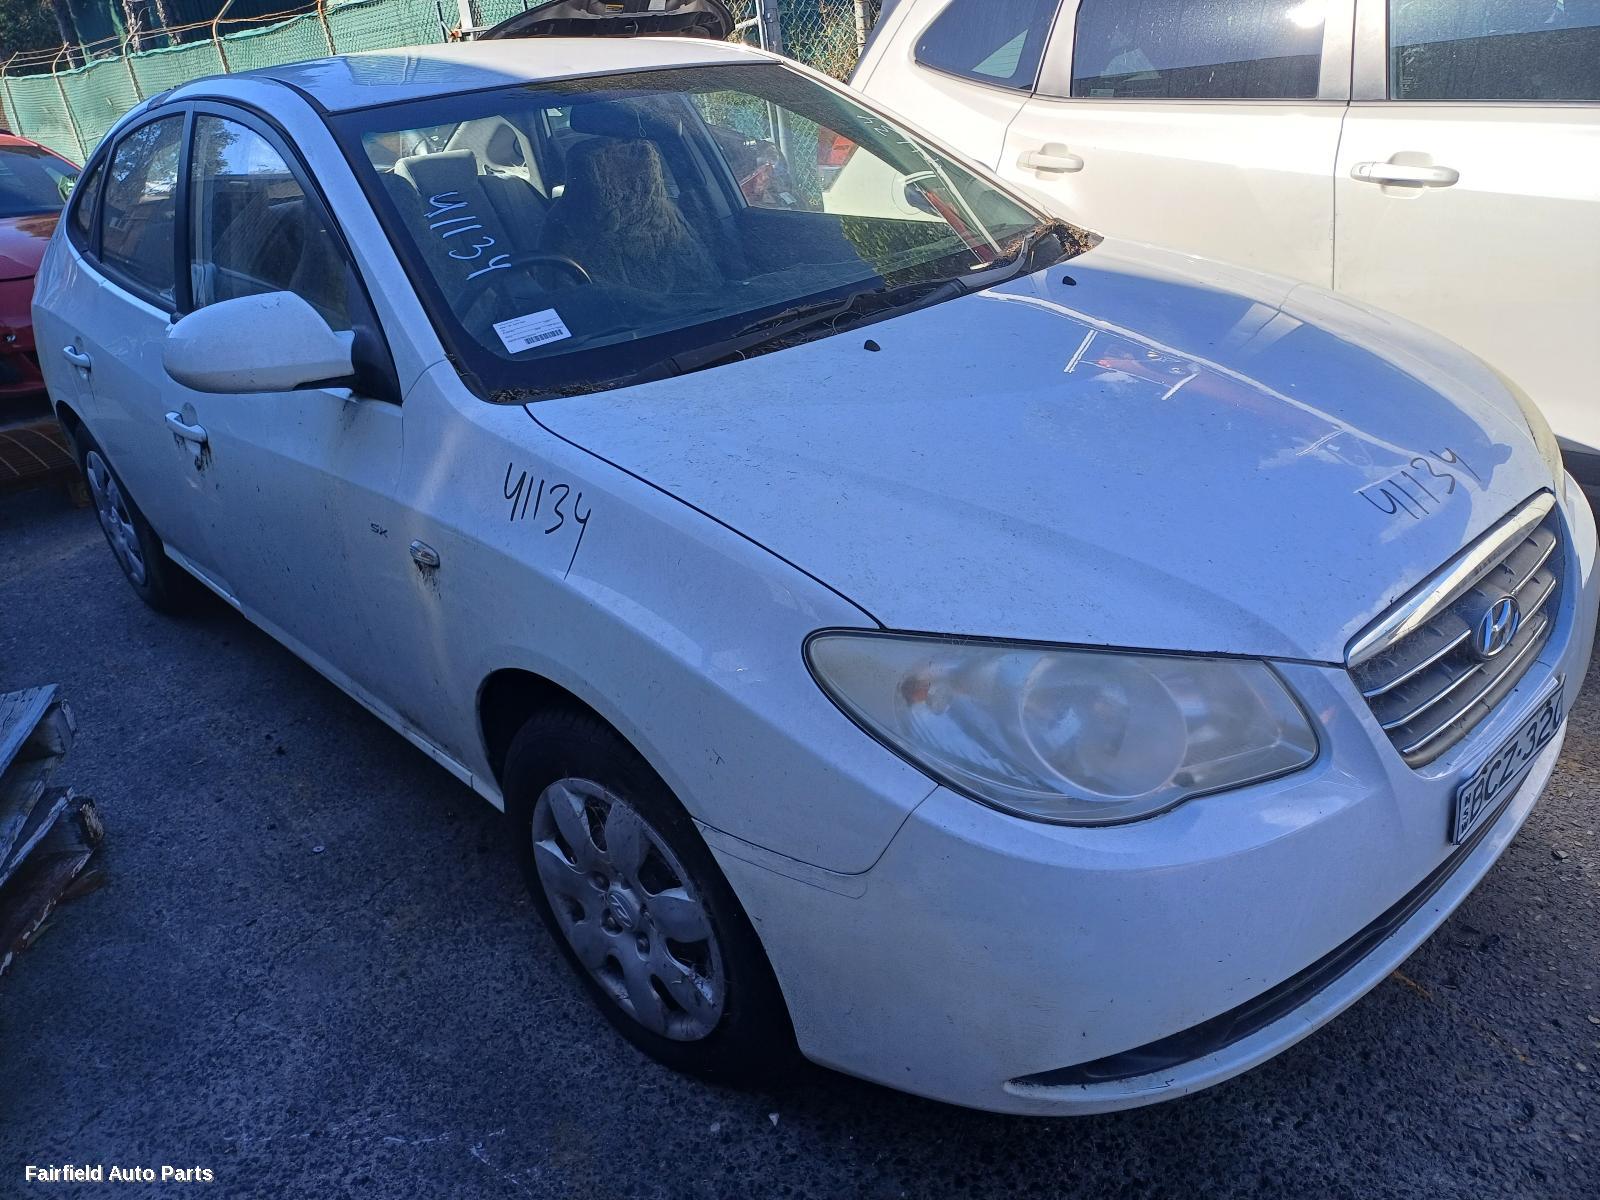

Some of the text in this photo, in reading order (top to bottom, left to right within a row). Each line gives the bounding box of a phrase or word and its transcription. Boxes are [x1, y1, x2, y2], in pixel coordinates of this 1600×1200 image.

[424, 191, 512, 280] 41134
[503, 462, 592, 580] 41134
[1358, 447, 1482, 520] 41134
